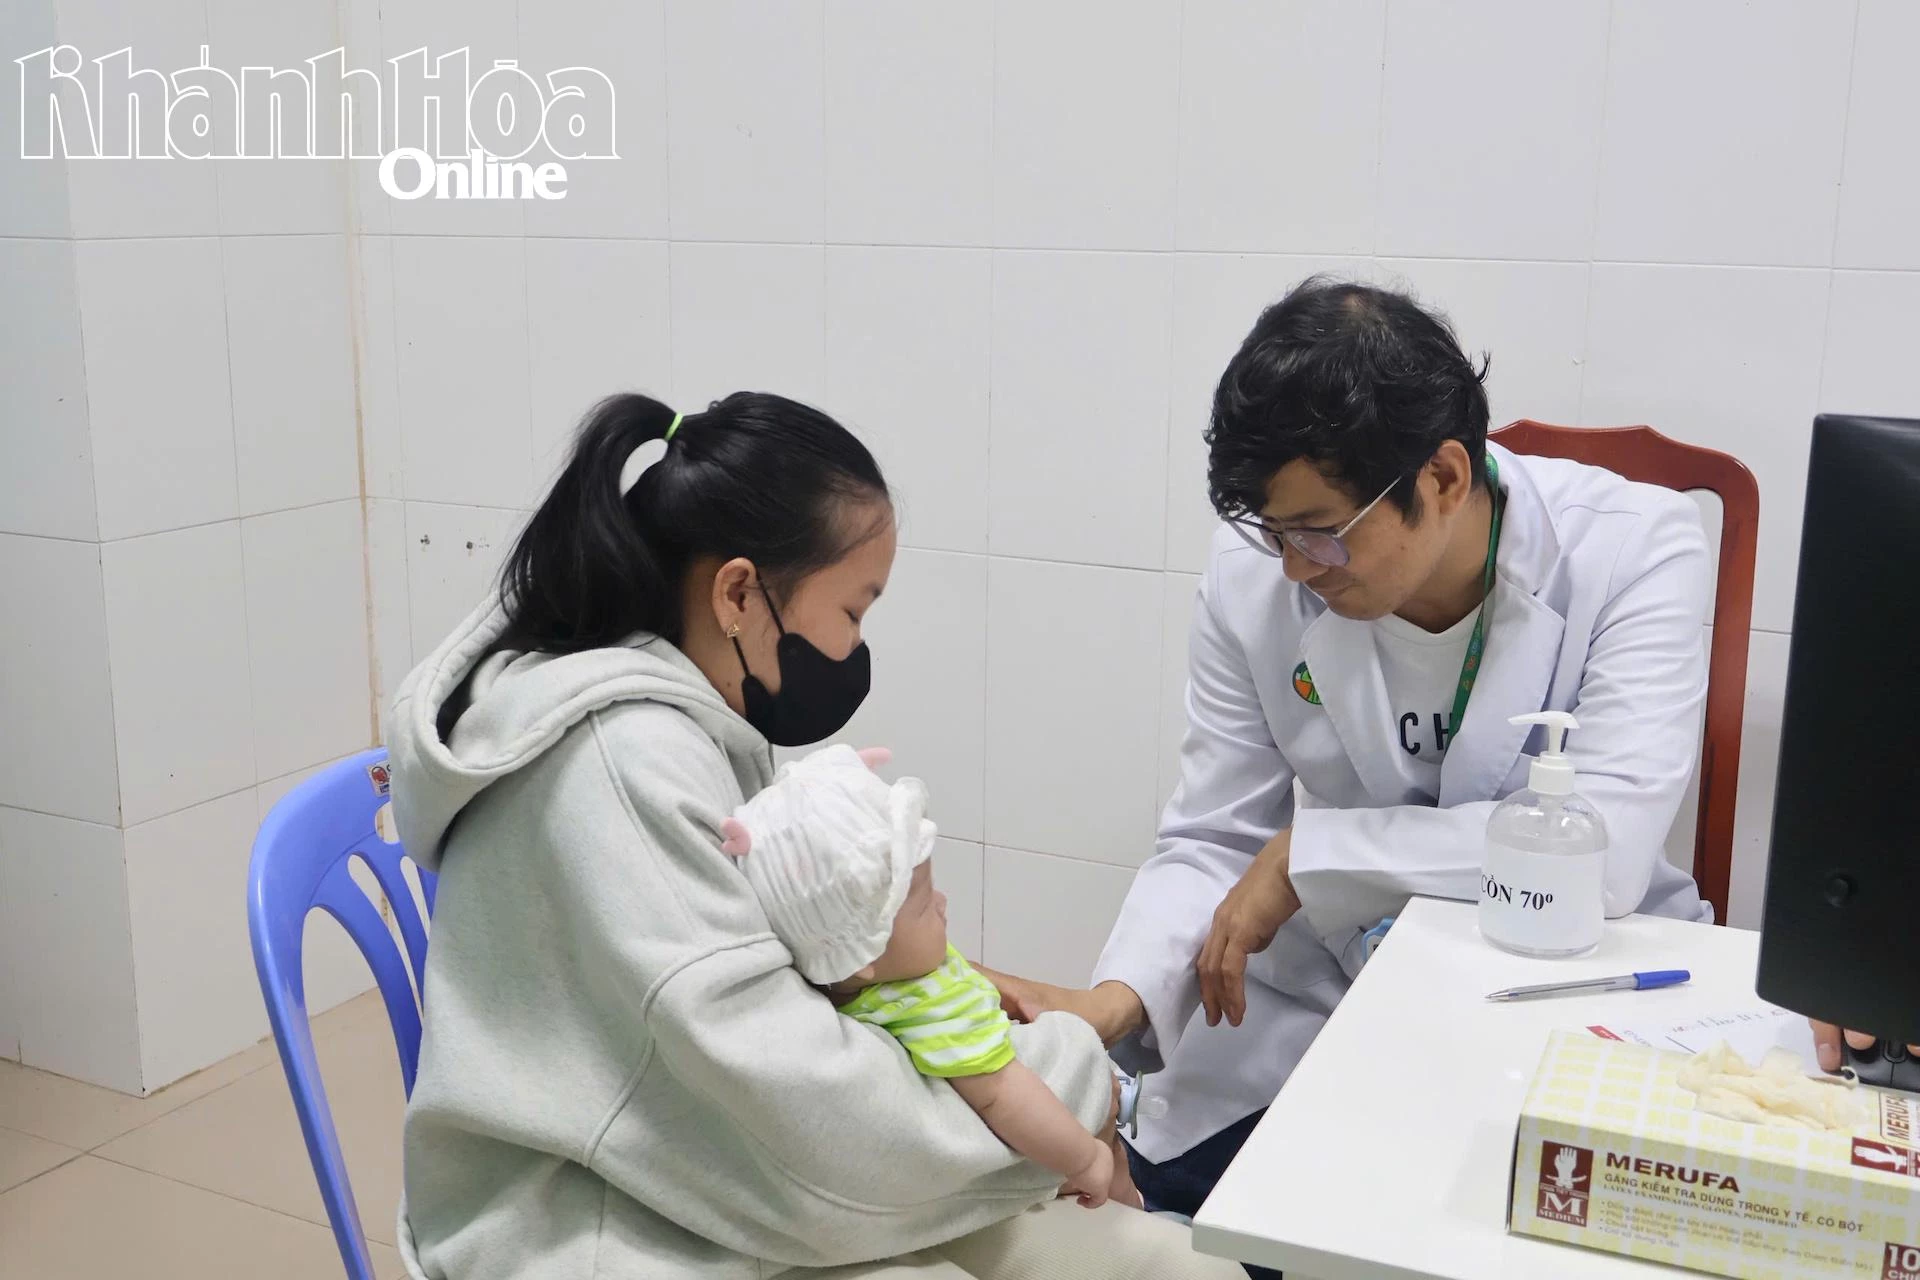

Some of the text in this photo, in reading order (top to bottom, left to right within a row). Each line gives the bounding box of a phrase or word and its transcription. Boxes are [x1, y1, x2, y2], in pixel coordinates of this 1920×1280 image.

[1605, 1151, 1741, 1194] MERUFA
[1542, 1191, 1584, 1217] M
[1738, 1199, 1780, 1216] TRONG
[1783, 1210, 1791, 1219] Y
[1539, 1208, 1585, 1225] MEDIUM
